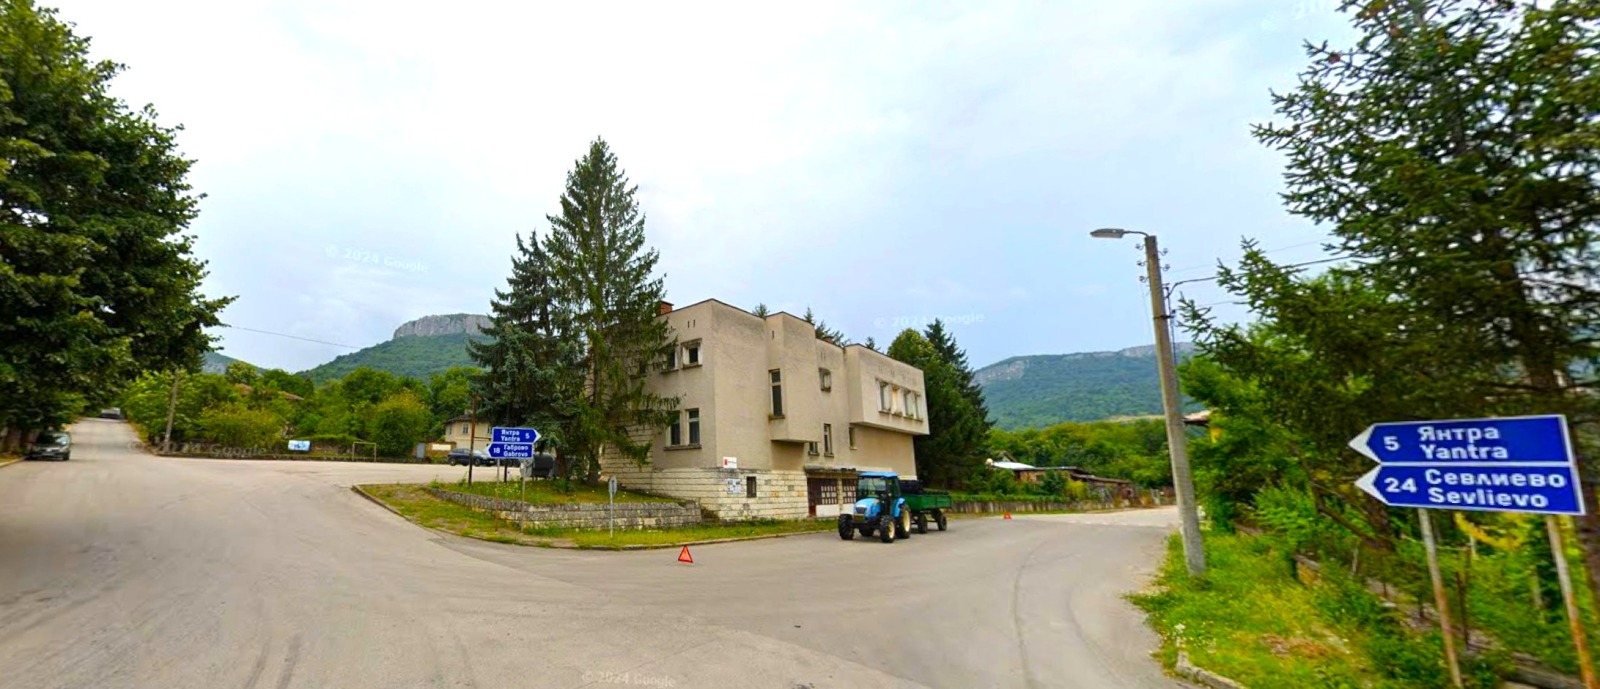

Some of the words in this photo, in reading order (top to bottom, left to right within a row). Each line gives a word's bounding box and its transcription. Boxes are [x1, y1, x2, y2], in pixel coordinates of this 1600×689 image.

[501, 429, 520, 437] Янтра
[525, 432, 530, 440] 5
[1416, 425, 1500, 443] Янтра
[1383, 436, 1400, 451] 5
[1419, 443, 1509, 459] Yantra
[1384, 477, 1418, 493] 24
[1424, 468, 1568, 488] Севлиево
[1427, 487, 1549, 508] Sevlievo
